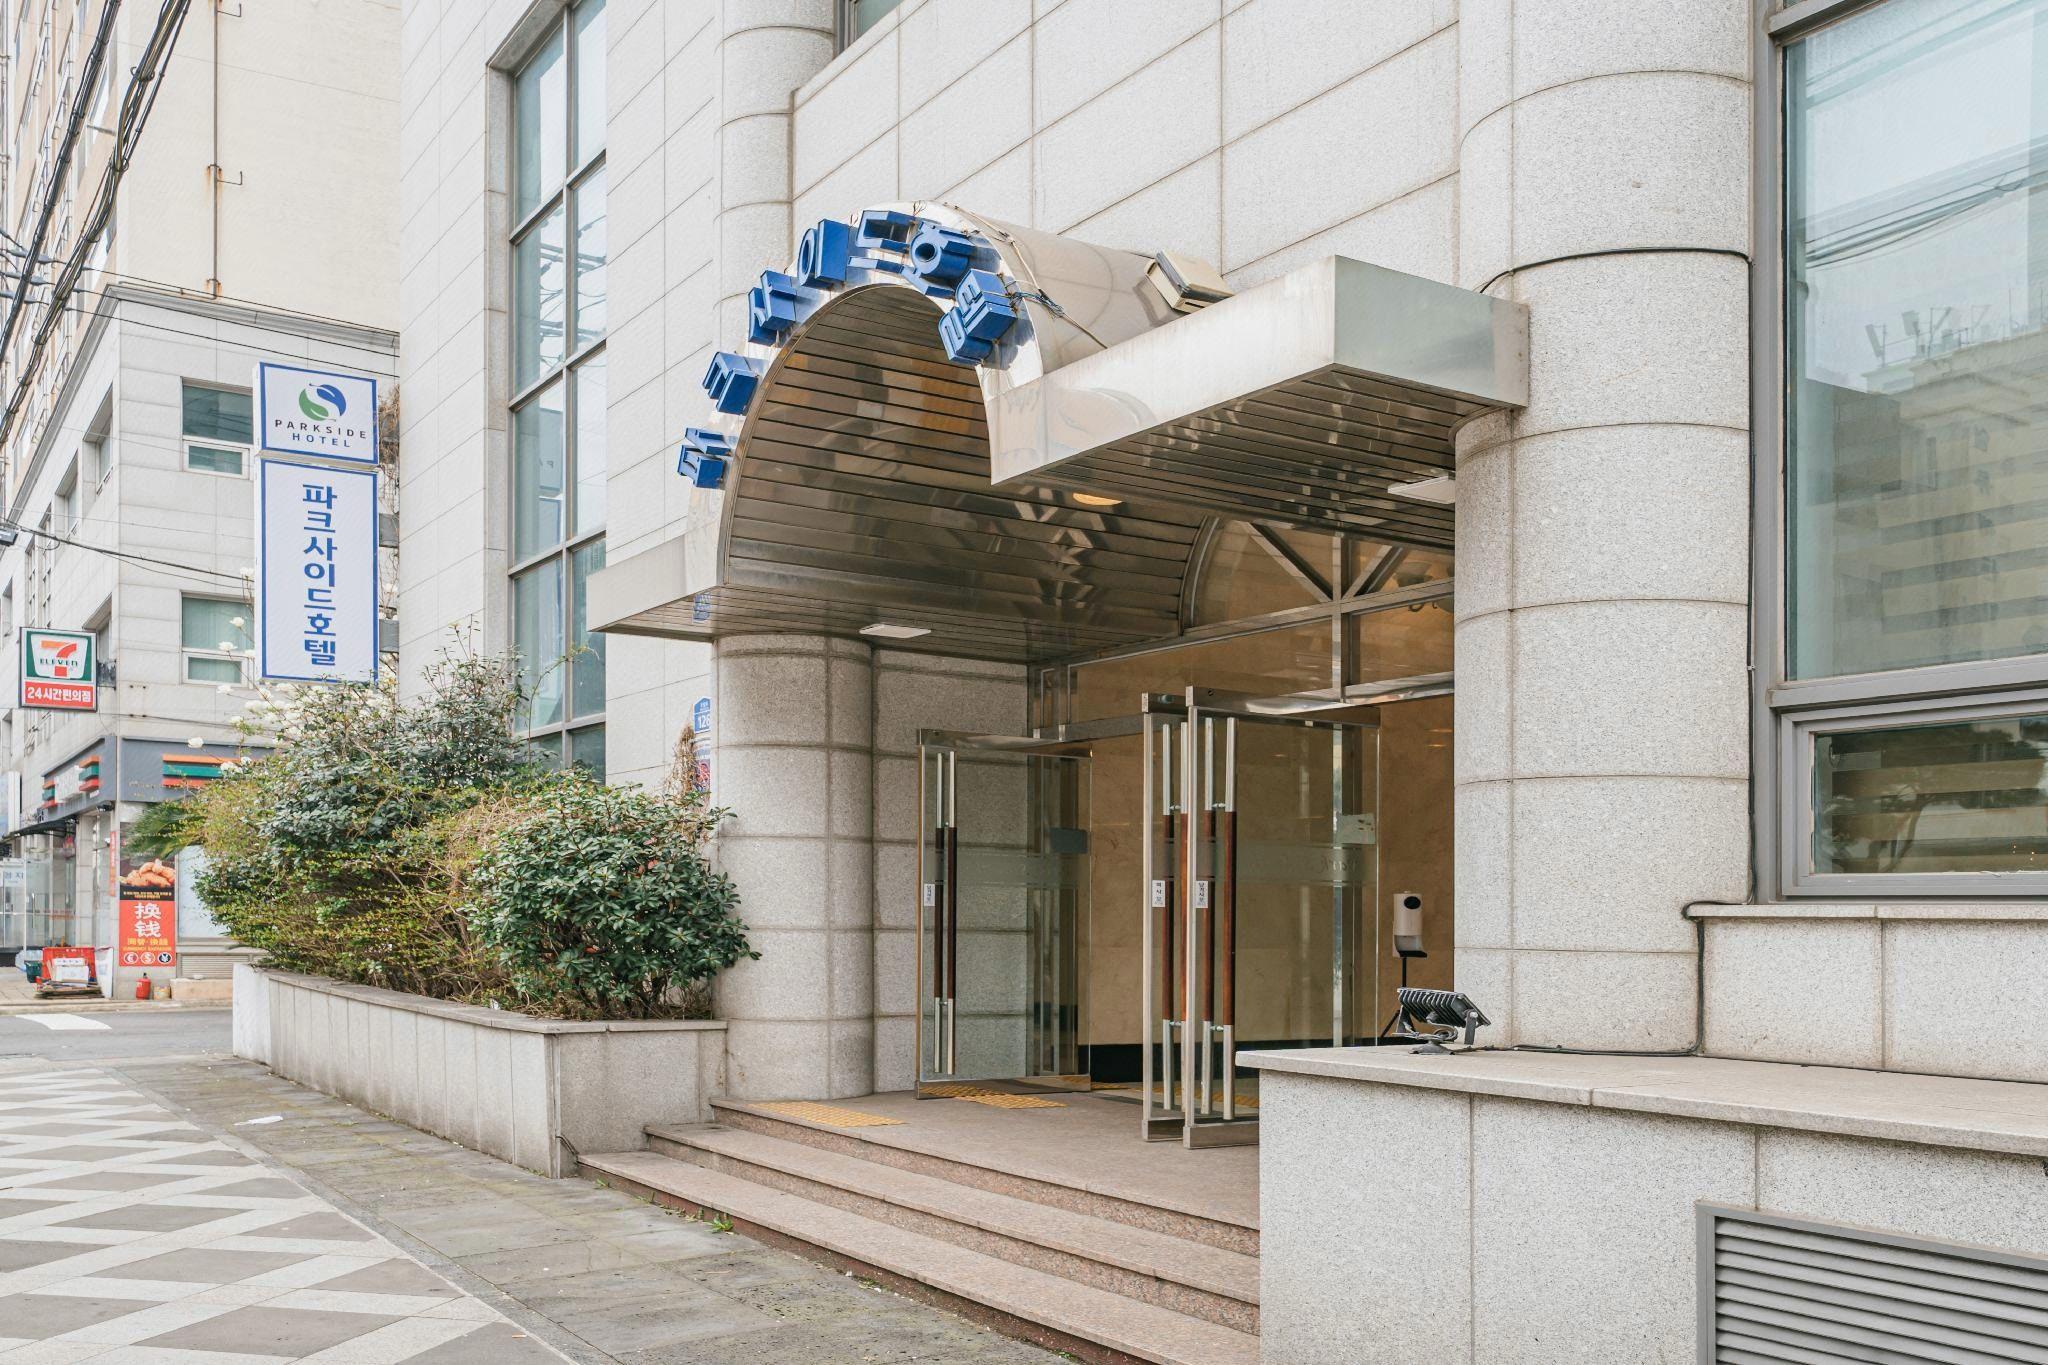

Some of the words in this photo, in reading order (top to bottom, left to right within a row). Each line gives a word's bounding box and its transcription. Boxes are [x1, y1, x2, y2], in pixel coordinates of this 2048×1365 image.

[274, 419, 367, 439] PARKSIDE
[292, 432, 351, 448] HOTEL
[302, 483, 338, 667] 파크사이드호텔
[27, 686, 91, 703] 24시간편의점
